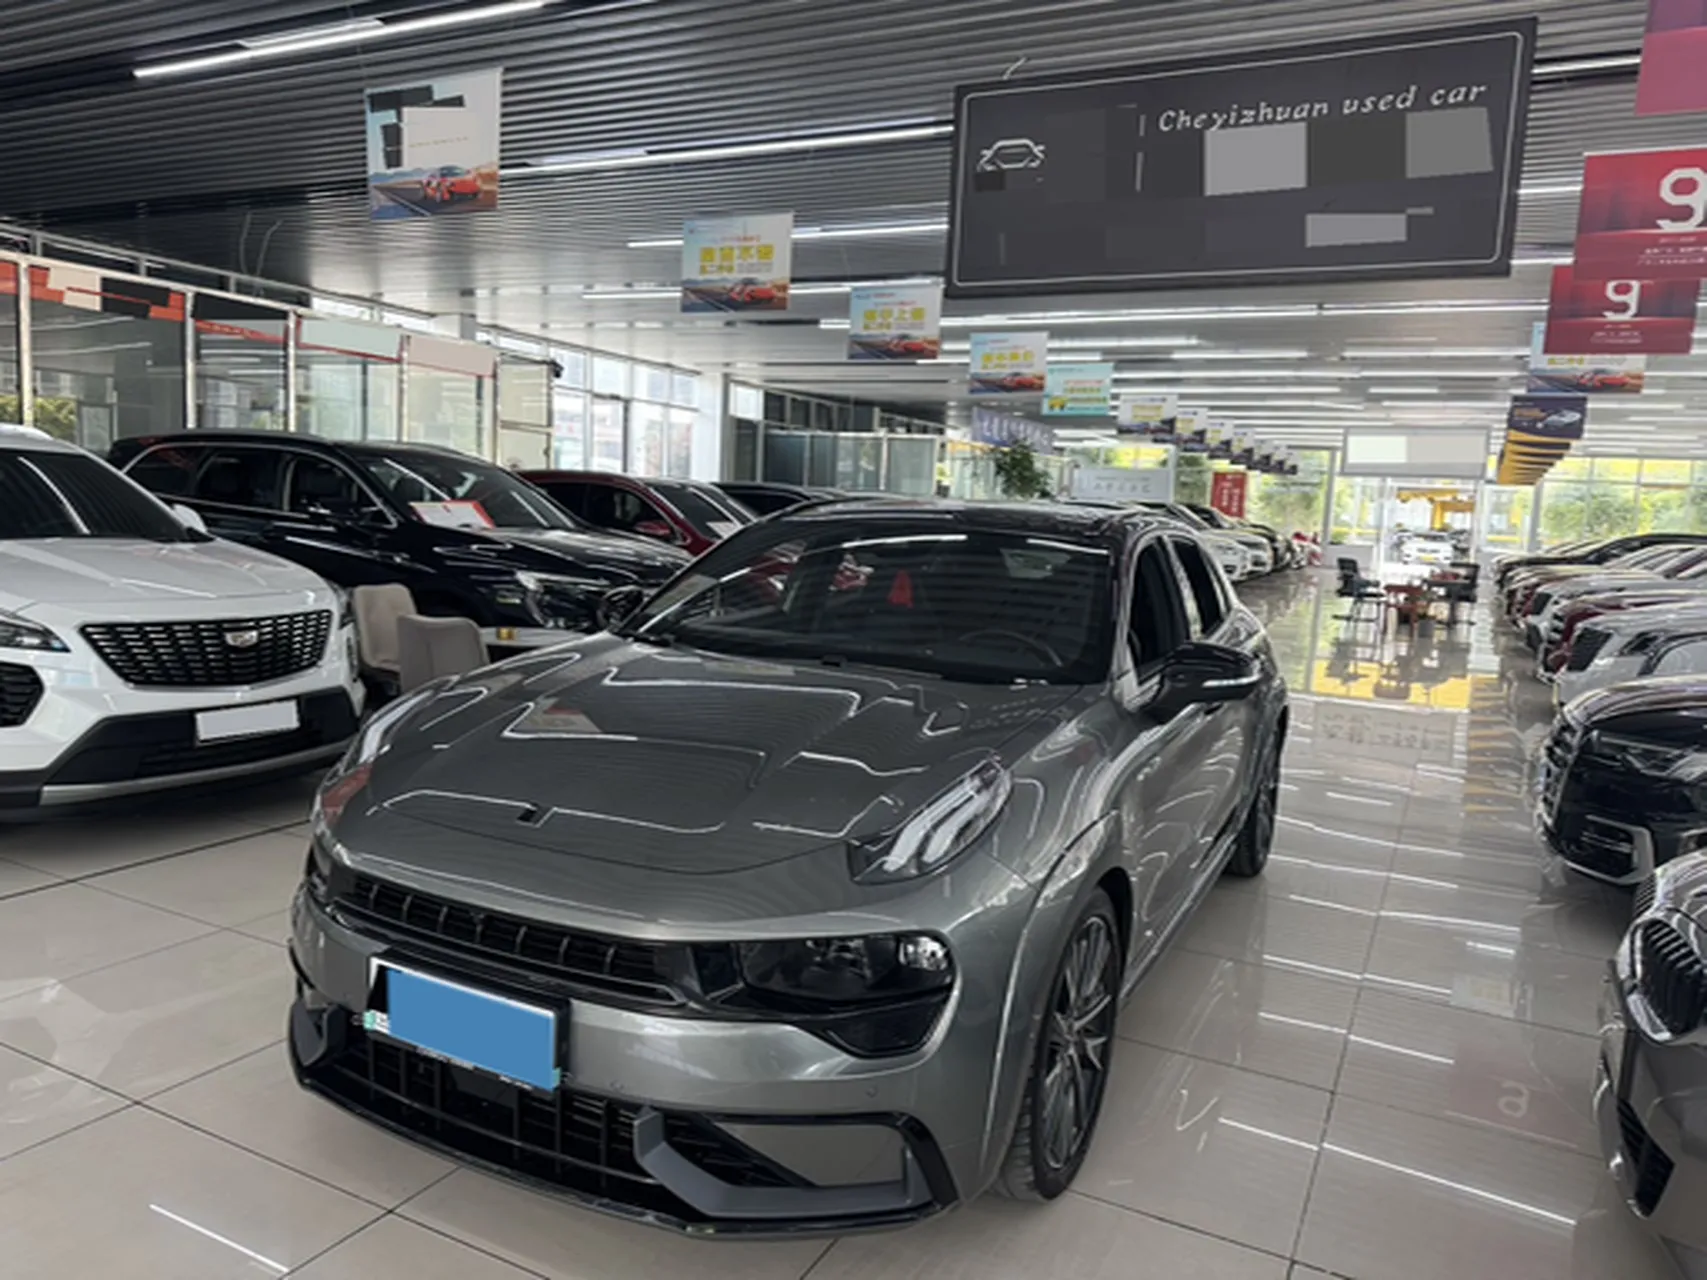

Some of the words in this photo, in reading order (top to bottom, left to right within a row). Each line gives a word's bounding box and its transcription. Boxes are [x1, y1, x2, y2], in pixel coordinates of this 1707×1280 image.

[1158, 101, 1330, 132] Cheyizhuan
[1342, 84, 1418, 115] used
[1429, 84, 1487, 107] car
[1656, 168, 1707, 233] 9
[1602, 280, 1641, 321] 9
